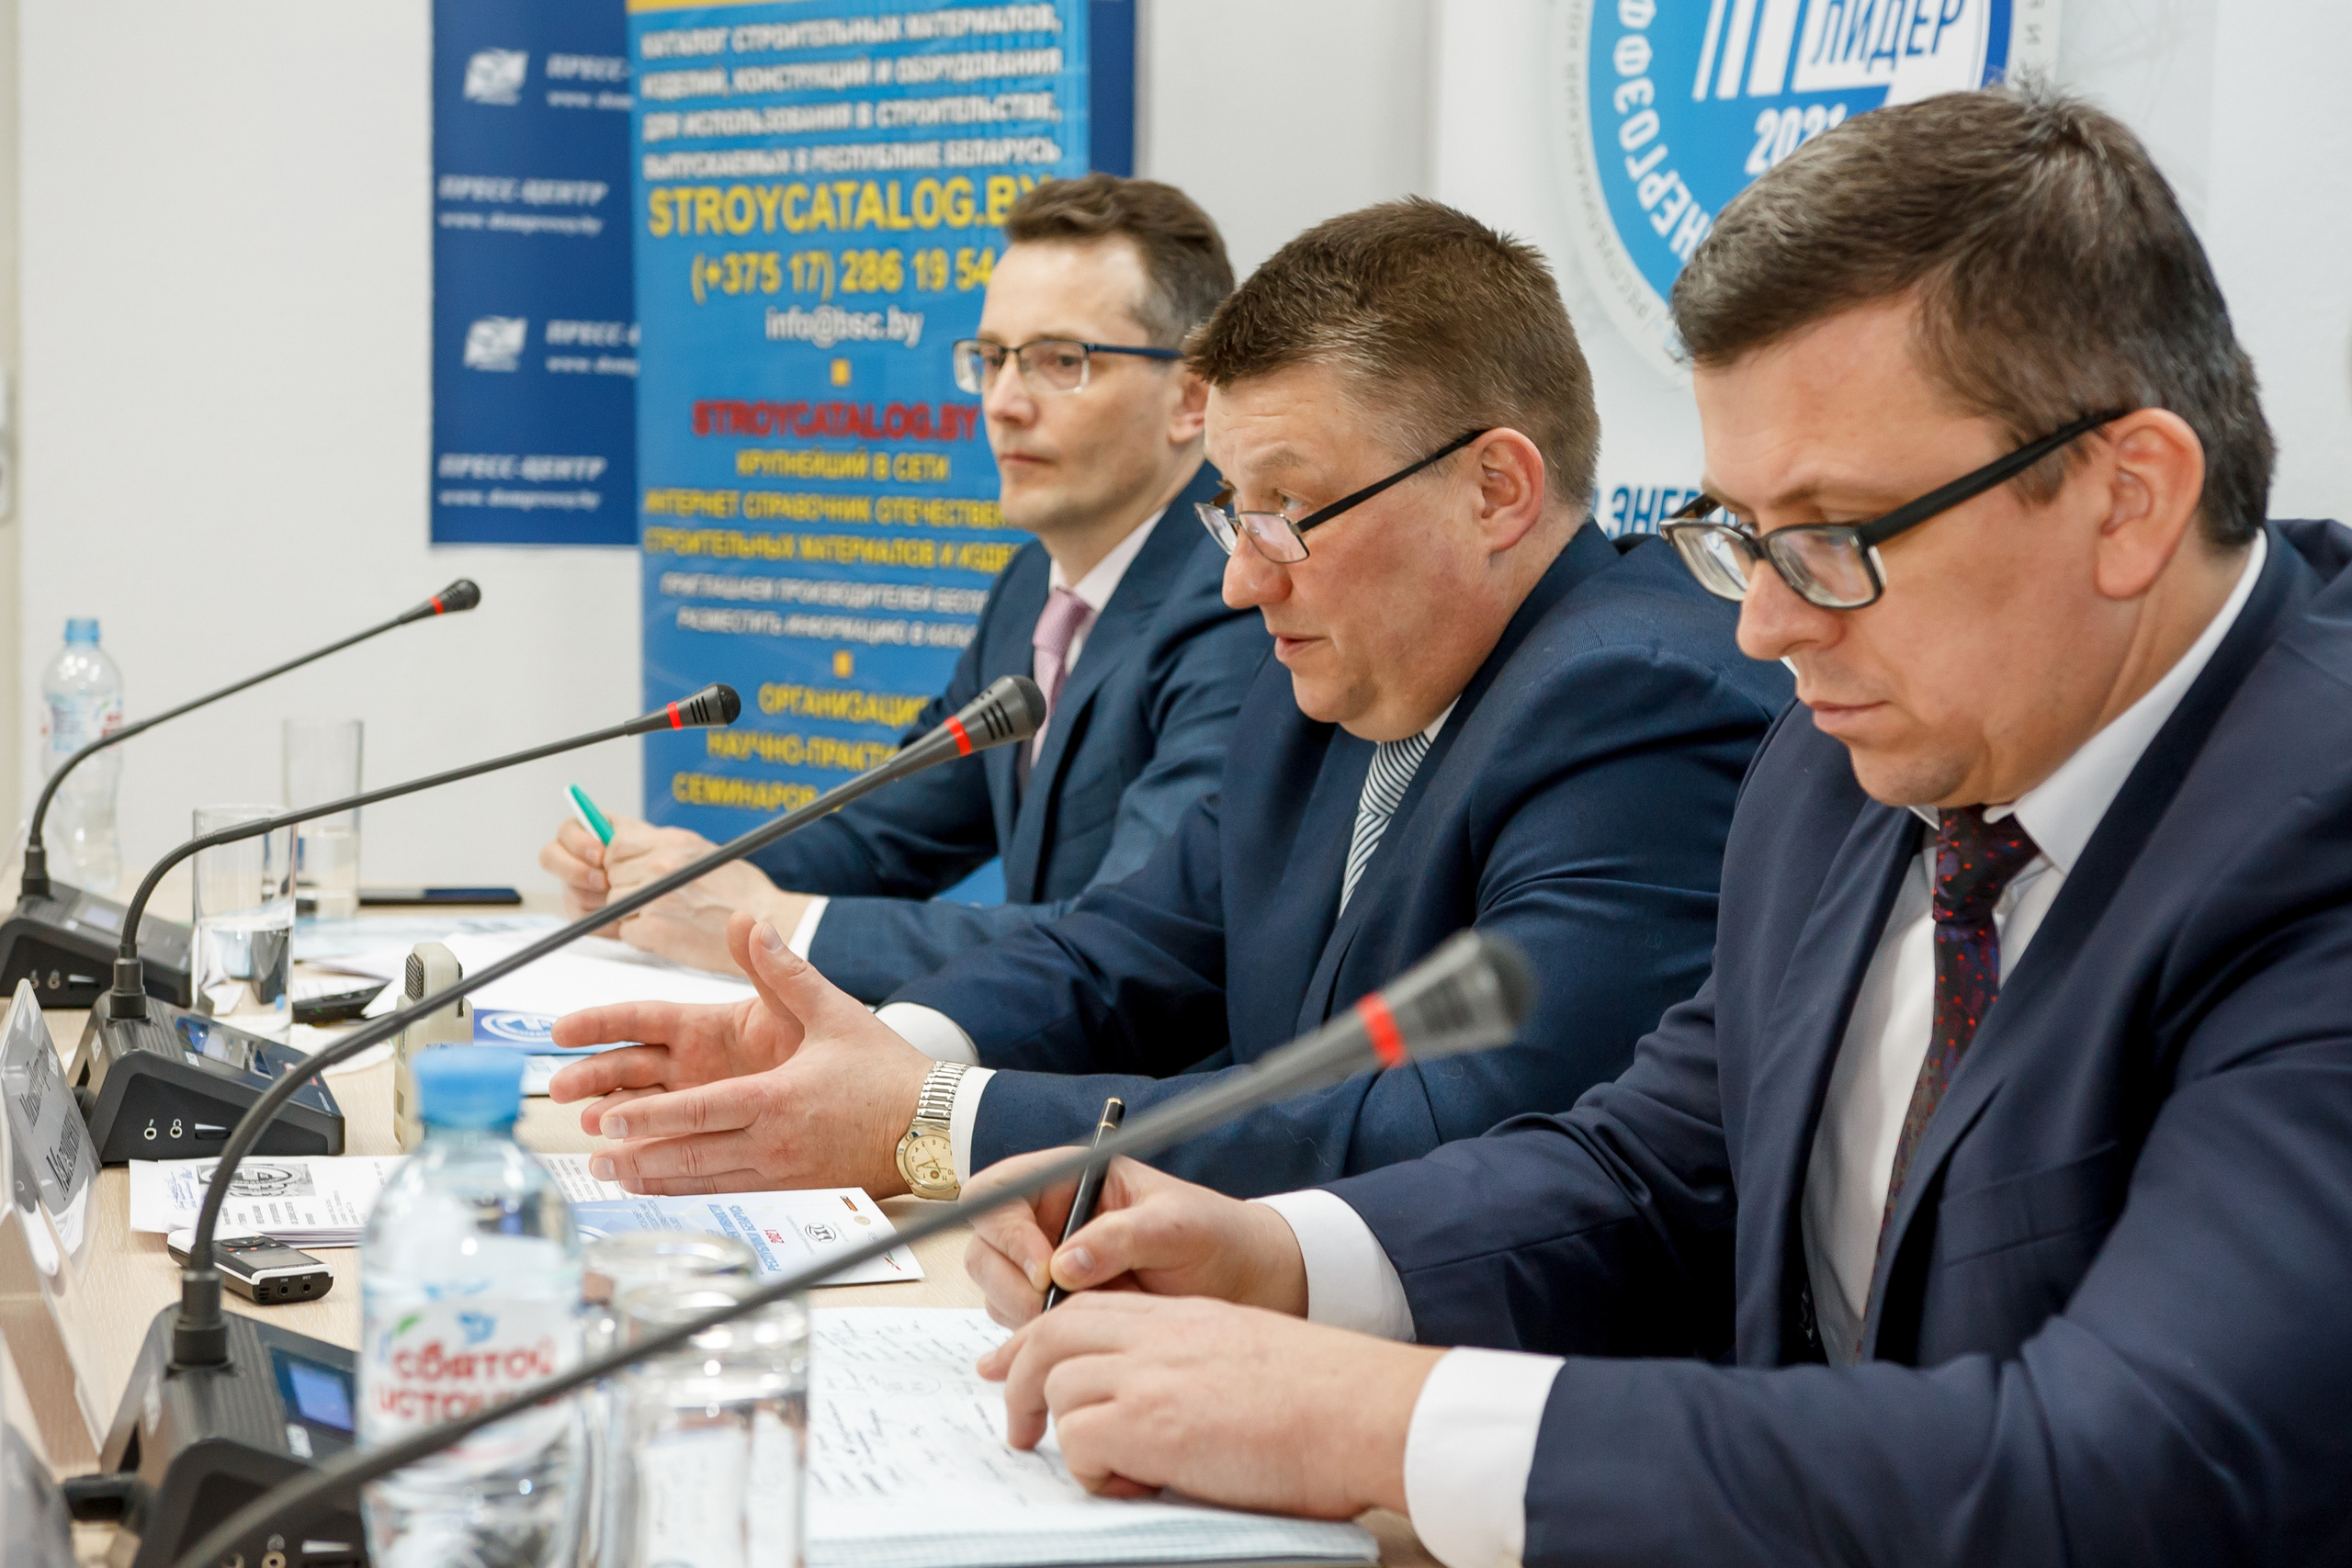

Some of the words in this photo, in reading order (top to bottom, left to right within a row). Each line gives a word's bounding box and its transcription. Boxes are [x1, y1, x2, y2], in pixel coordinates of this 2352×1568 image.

[1613, 0, 1713, 264] НЕРГОЭФФ
[693, 252, 779, 304] (+375
[789, 251, 833, 302] 17)
[842, 249, 902, 292] 286
[911, 248, 948, 291] 19
[767, 306, 922, 347] info@bsc.by
[694, 400, 978, 440] STROYCATALOG.BY
[894, 454, 950, 482] СЕТИ
